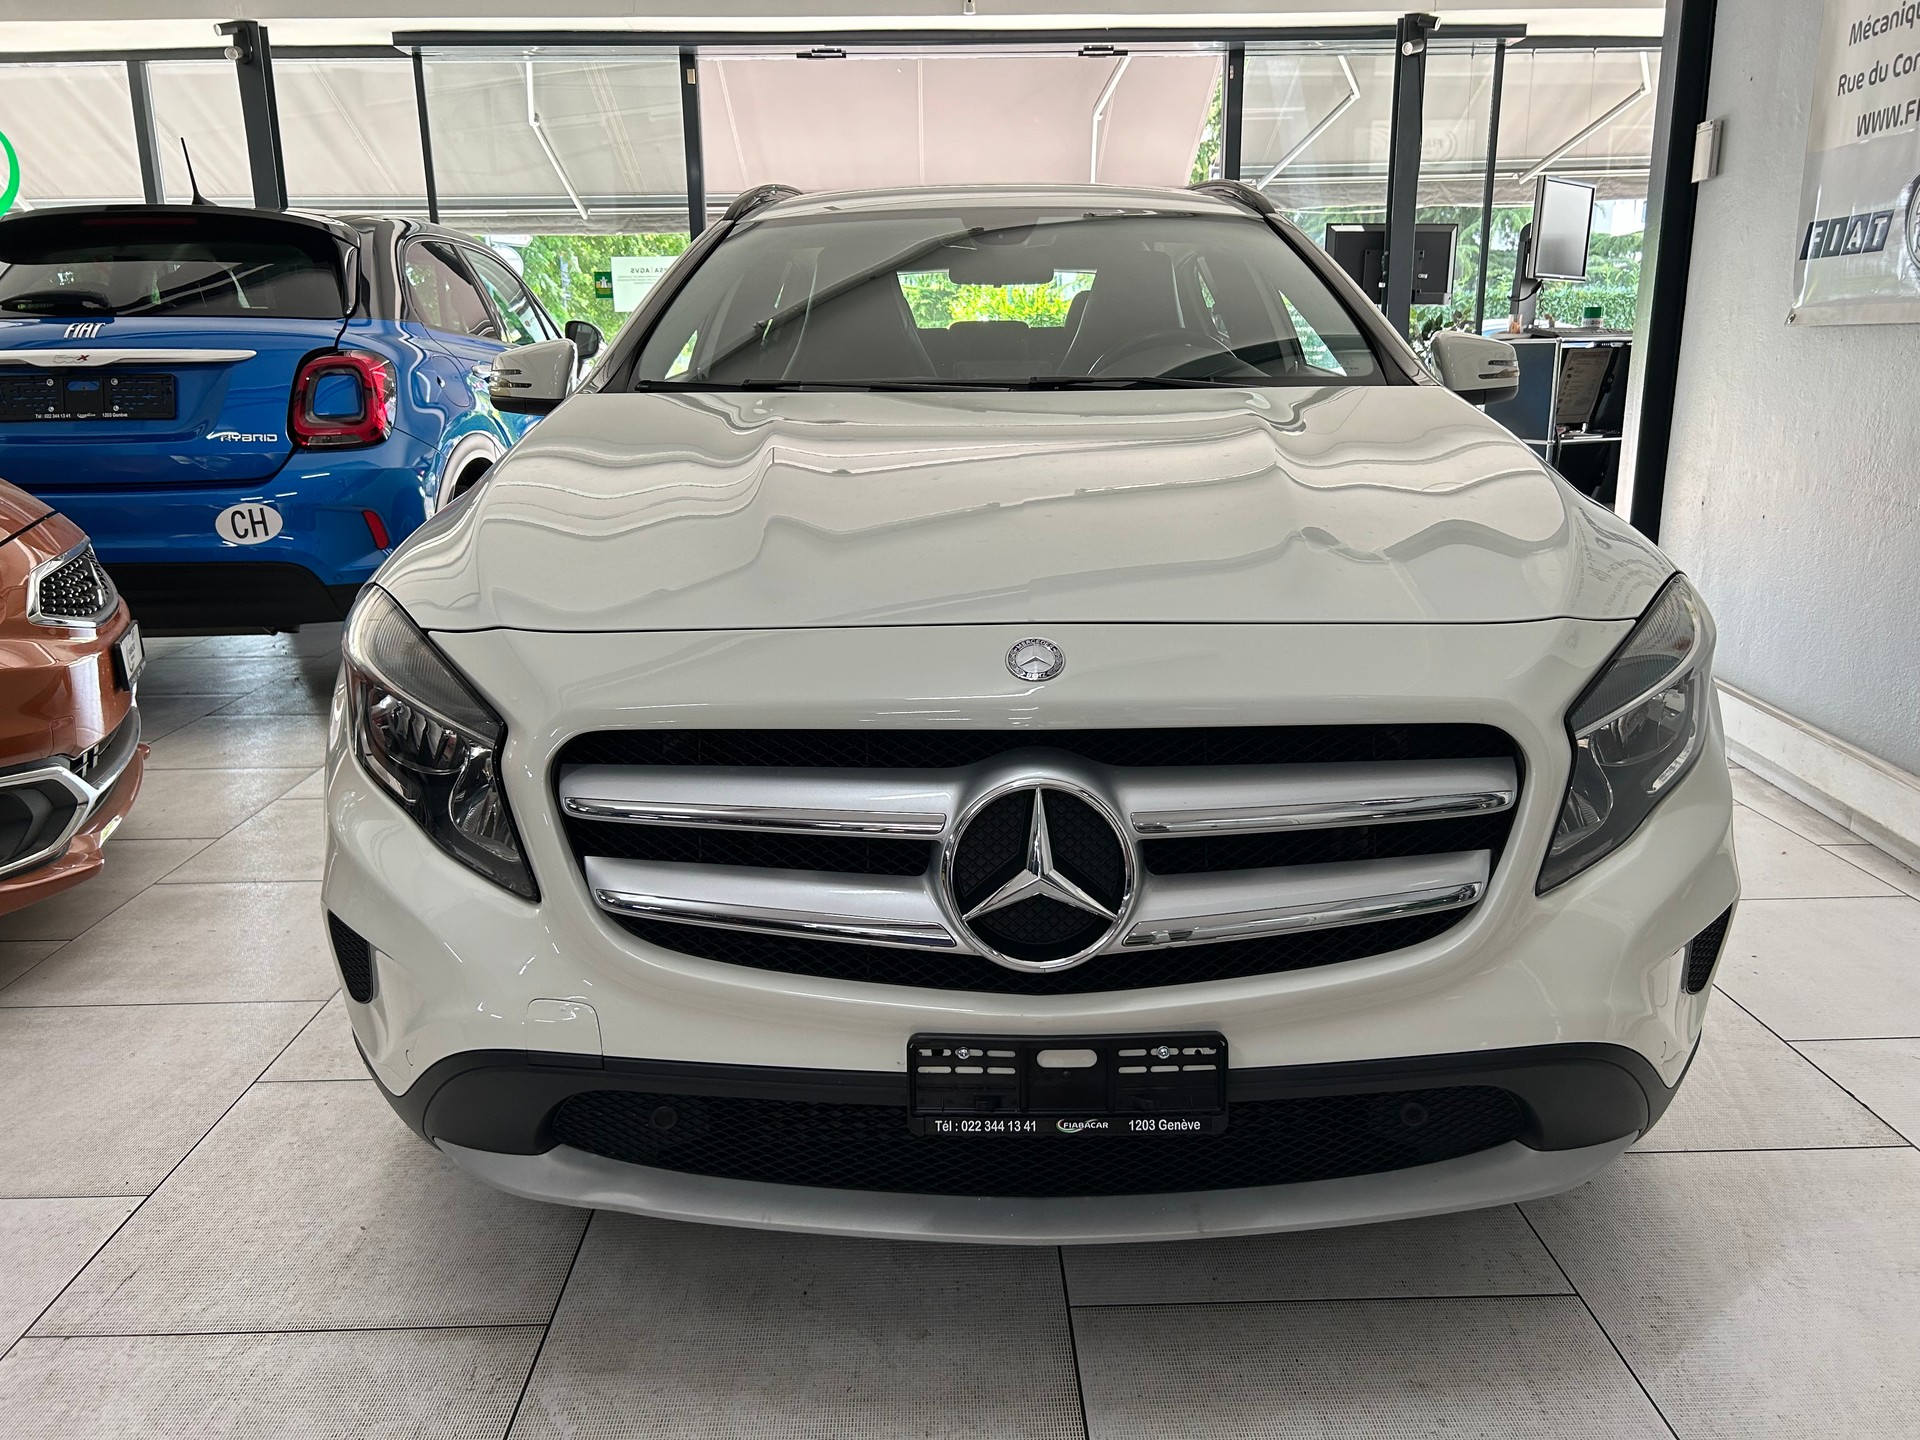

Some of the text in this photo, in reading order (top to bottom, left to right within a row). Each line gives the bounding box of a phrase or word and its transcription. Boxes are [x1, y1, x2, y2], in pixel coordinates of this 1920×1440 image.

[1837, 73, 1865, 97] Rue
[1868, 60, 1889, 86] du
[1805, 214, 1891, 255] FIAT
[63, 322, 106, 339] FIAT
[218, 431, 278, 442] HYBRID
[230, 507, 270, 539] CH
[934, 1120, 952, 1132] Tél
[961, 1120, 982, 1132] 022
[984, 1120, 1005, 1132] 344
[1007, 1120, 1021, 1132] 13
[1023, 1120, 1036, 1132] 41
[1062, 1121, 1109, 1130] FIABACAR
[1128, 1119, 1156, 1131] 1203
[1158, 1118, 1201, 1131] Genève
